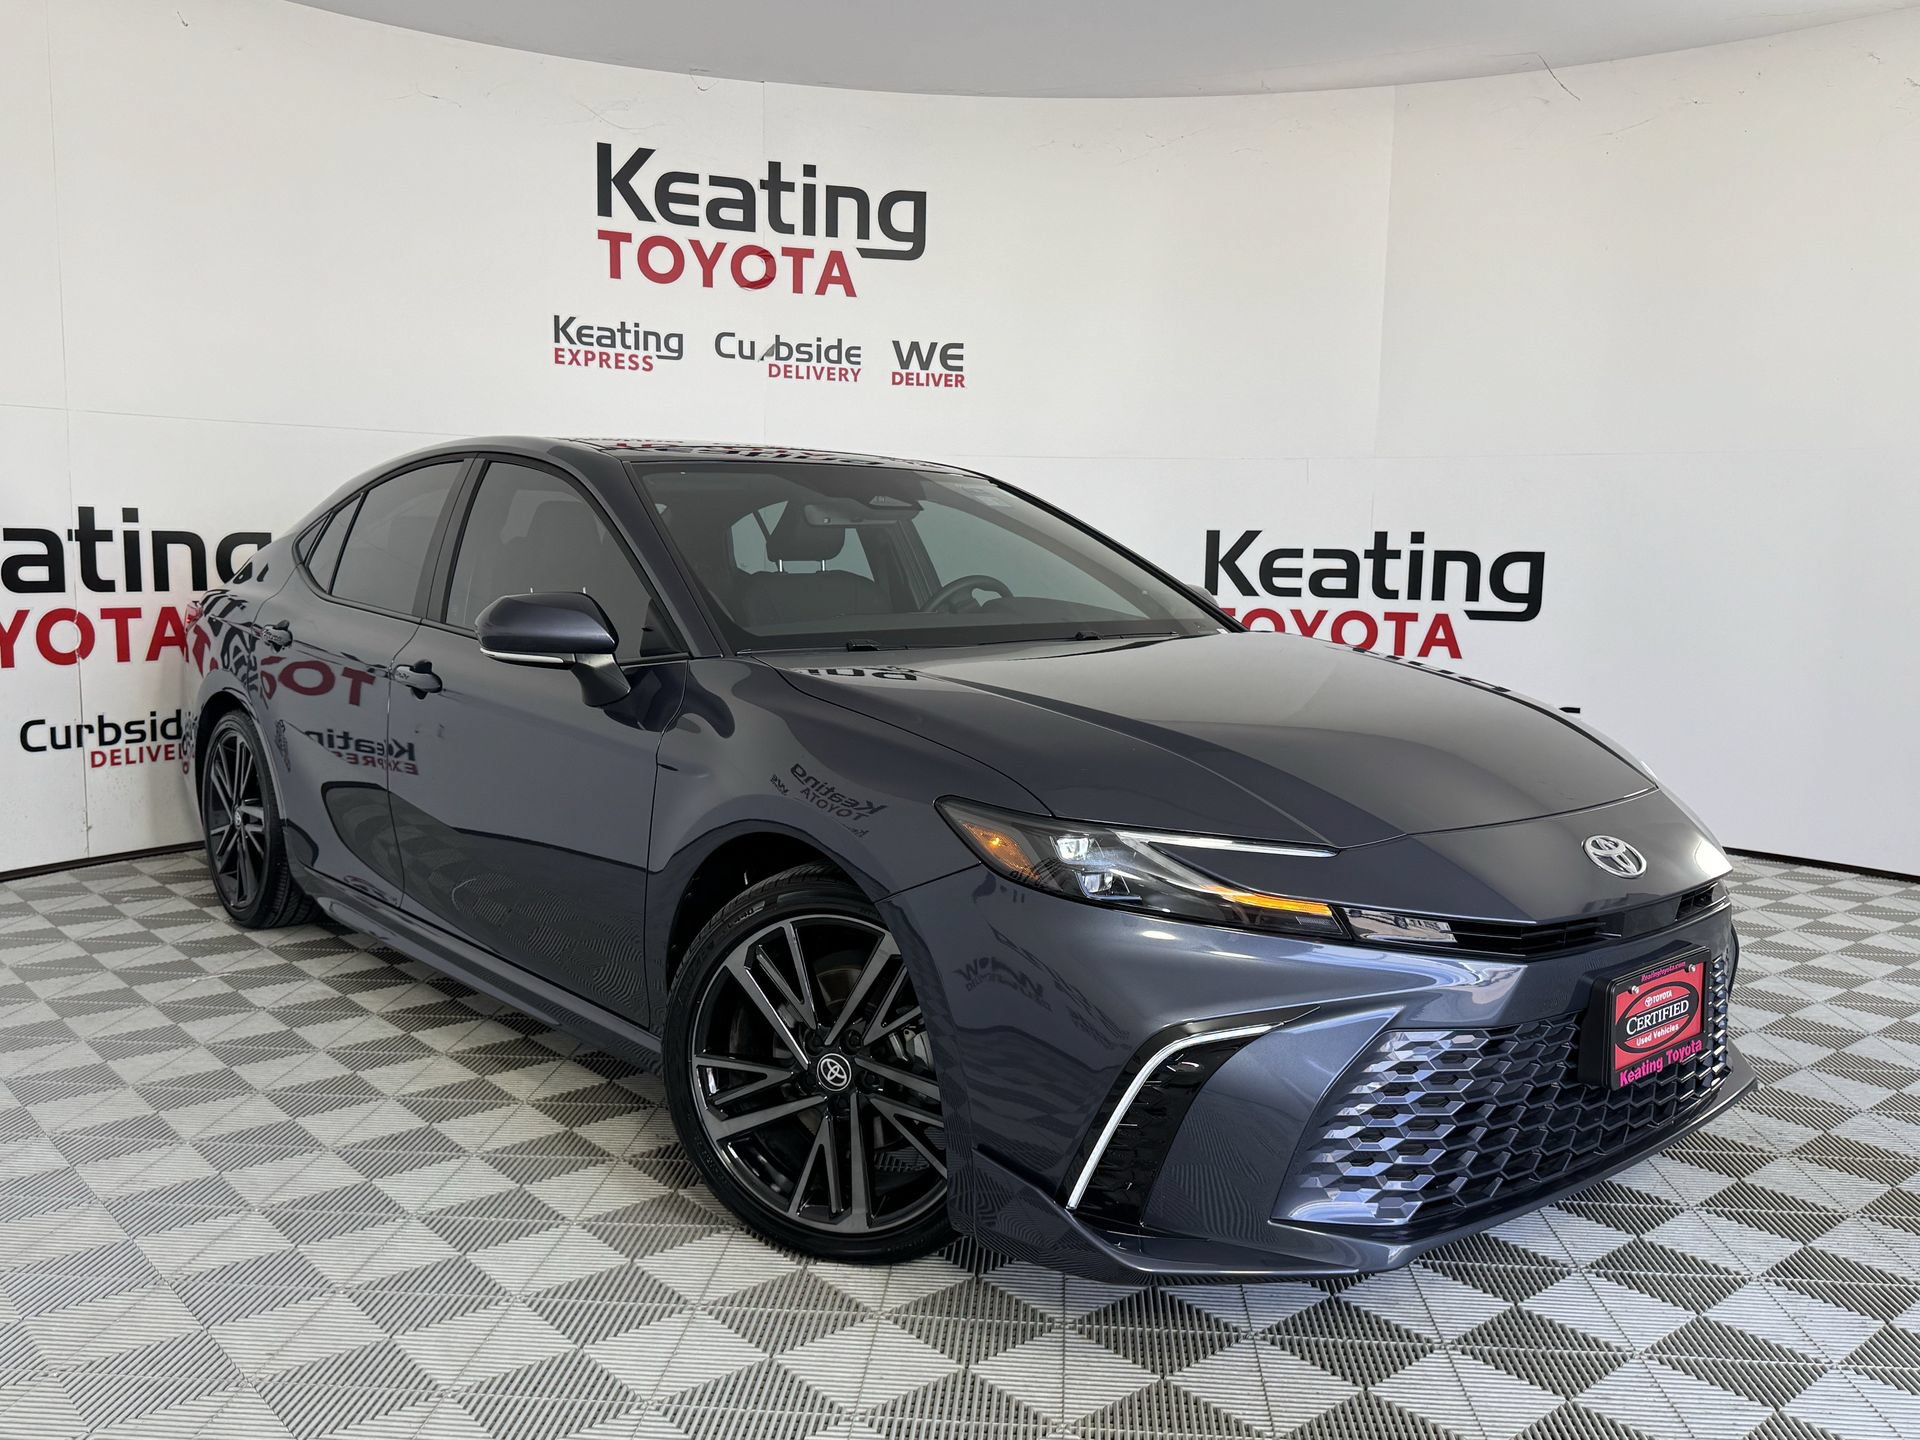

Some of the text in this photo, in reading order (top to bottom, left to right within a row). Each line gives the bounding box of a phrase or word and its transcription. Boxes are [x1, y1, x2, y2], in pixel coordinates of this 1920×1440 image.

[597, 142, 927, 261] Keating
[598, 230, 857, 298] TOYOTA
[554, 315, 683, 361] Keating
[714, 332, 862, 366] Cubside
[554, 348, 654, 372] EXPRESS
[768, 364, 862, 383] DELIVERY
[891, 372, 966, 388] DELIVER
[1205, 530, 1546, 622] Keating
[1219, 607, 1462, 659] YOTA
[1653, 990, 1673, 1003] TOYOTA
[1626, 1000, 1690, 1035] CERTIFIED
[1636, 1023, 1680, 1047] Used Vehicles
[1620, 1038, 1703, 1088] Keating Toyota
